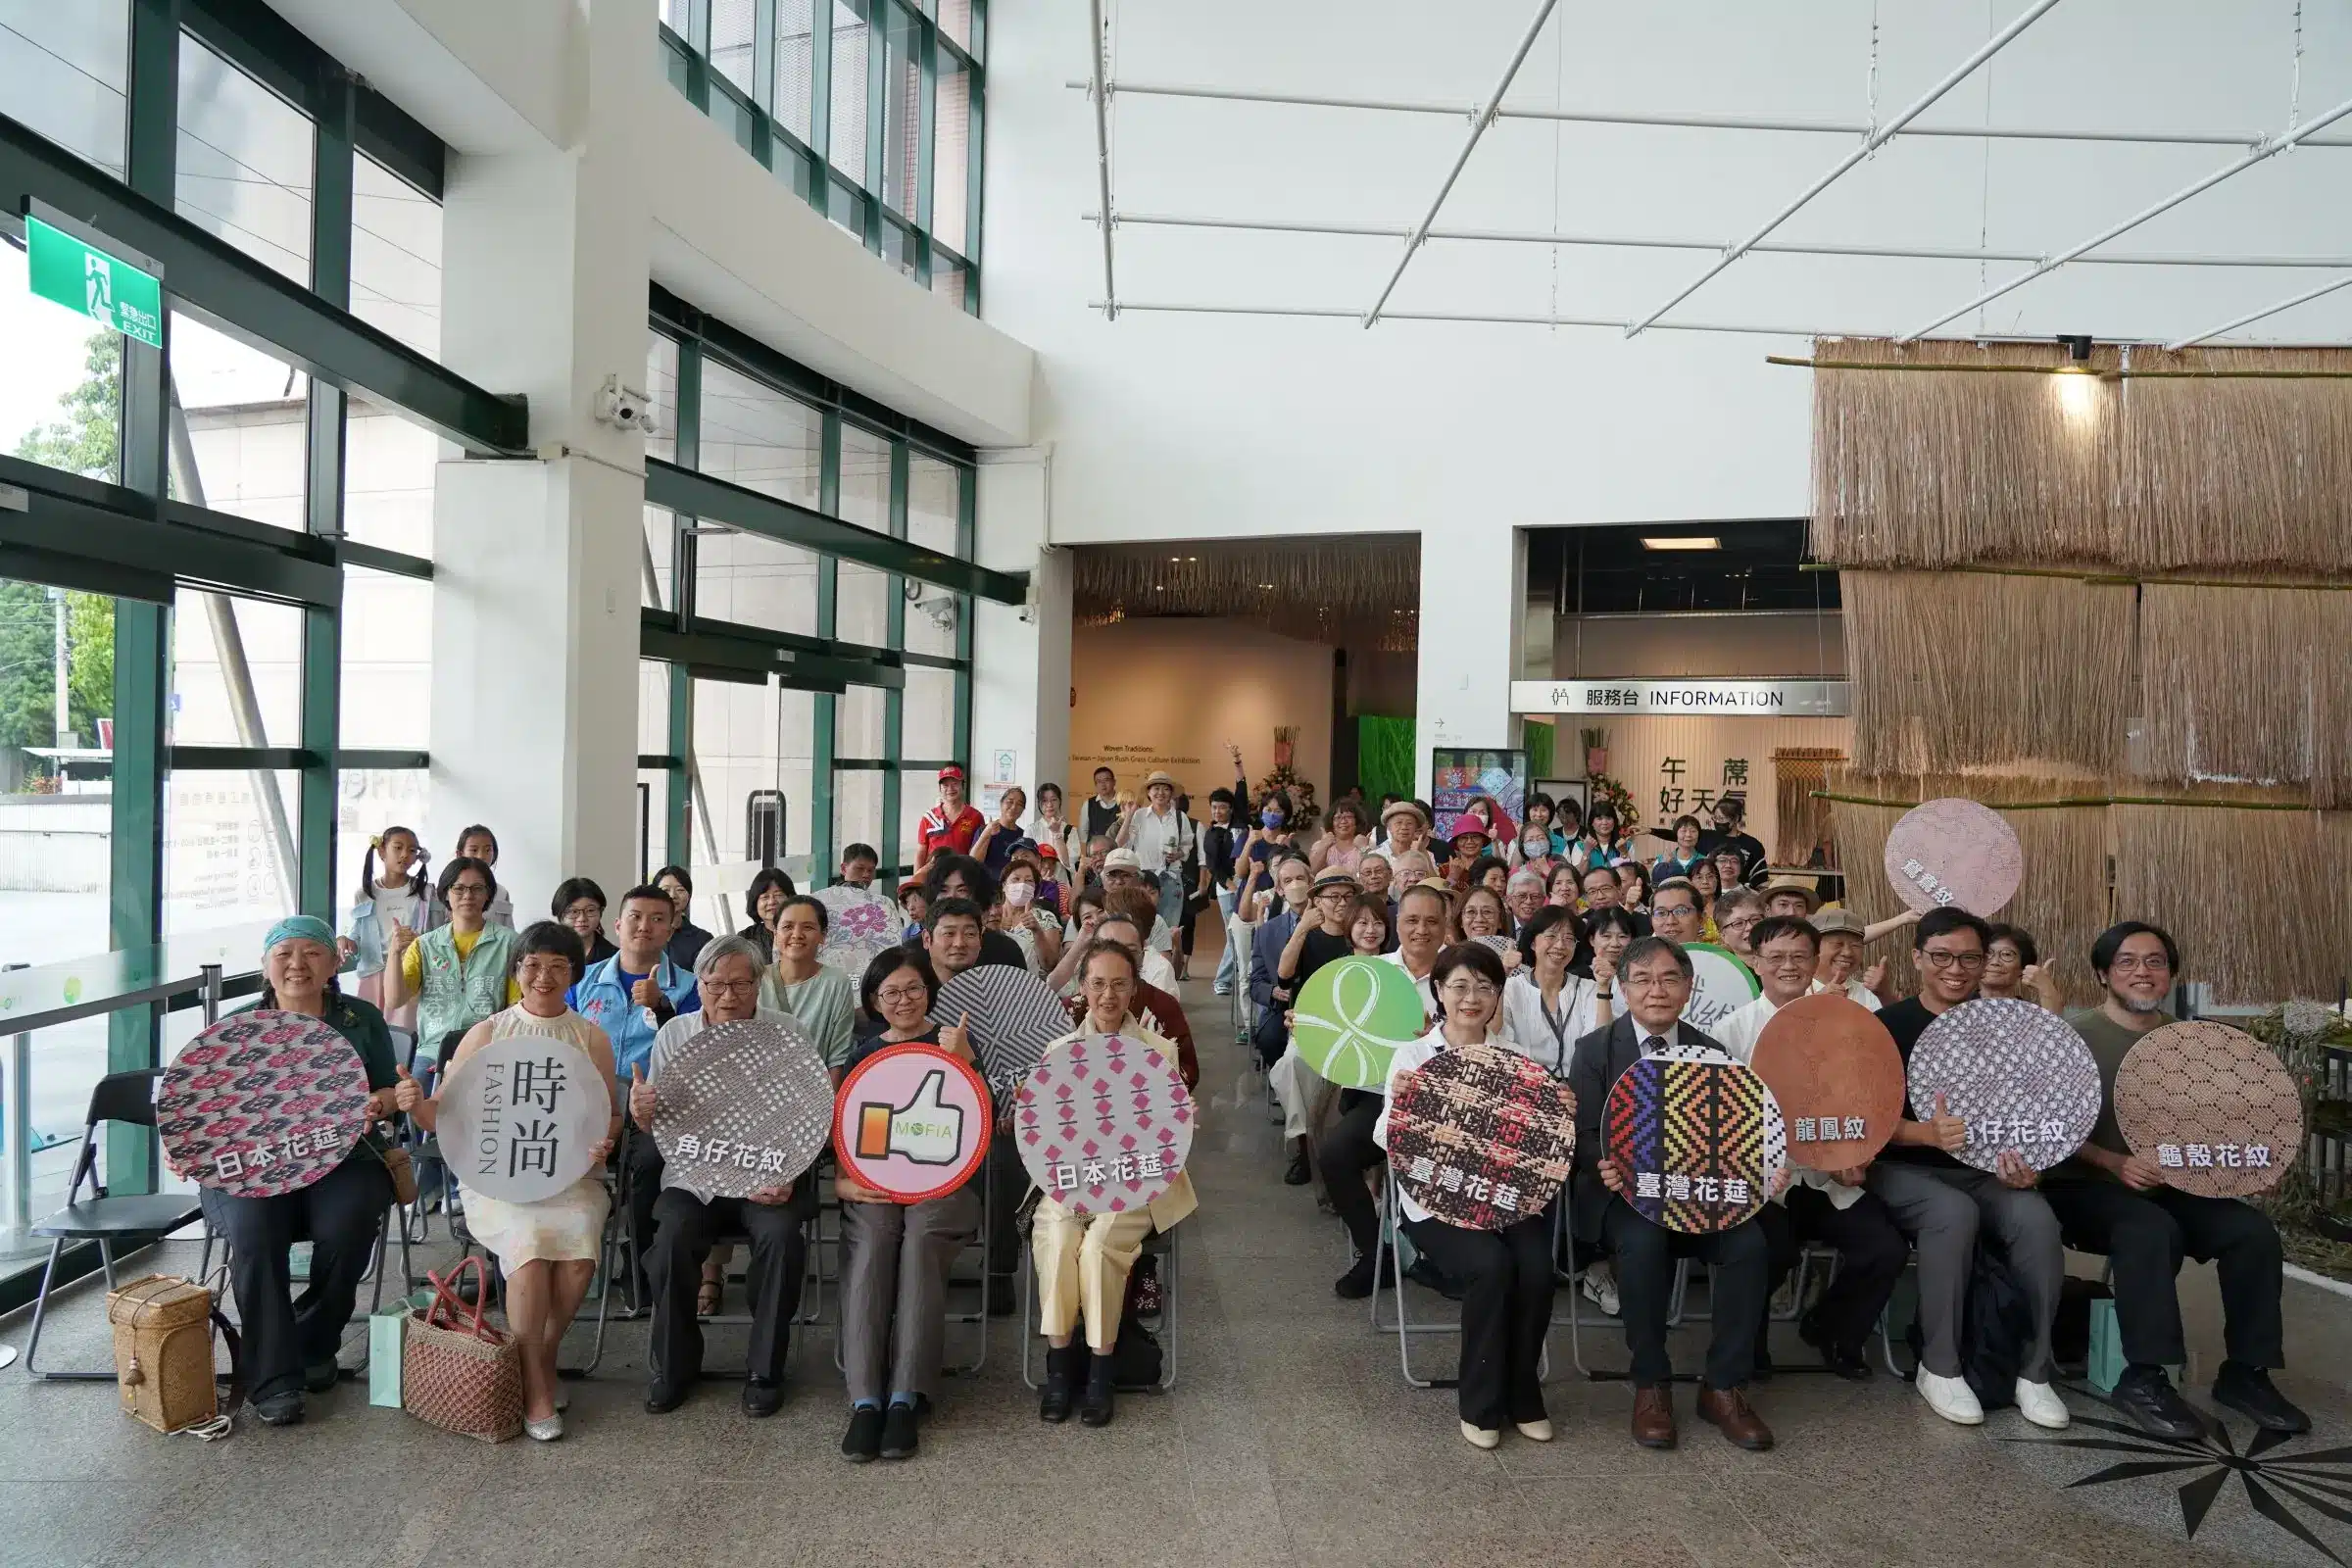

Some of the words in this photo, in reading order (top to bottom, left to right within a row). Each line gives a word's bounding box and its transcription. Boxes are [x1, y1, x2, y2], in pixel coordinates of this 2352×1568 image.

[122, 319, 157, 342] EXIT
[1587, 689, 1640, 707] 服務台
[1650, 690, 1784, 707] INFORMATION
[1130, 755, 1147, 763] Grass
[1147, 755, 1170, 764] Culture
[1170, 756, 1200, 764] Exhibition
[478, 1062, 505, 1175] FASHION
[509, 1056, 567, 1178] 時尚
[1795, 1116, 1866, 1142] 龍鳳紋
[674, 1133, 786, 1174] 角仔花紋
